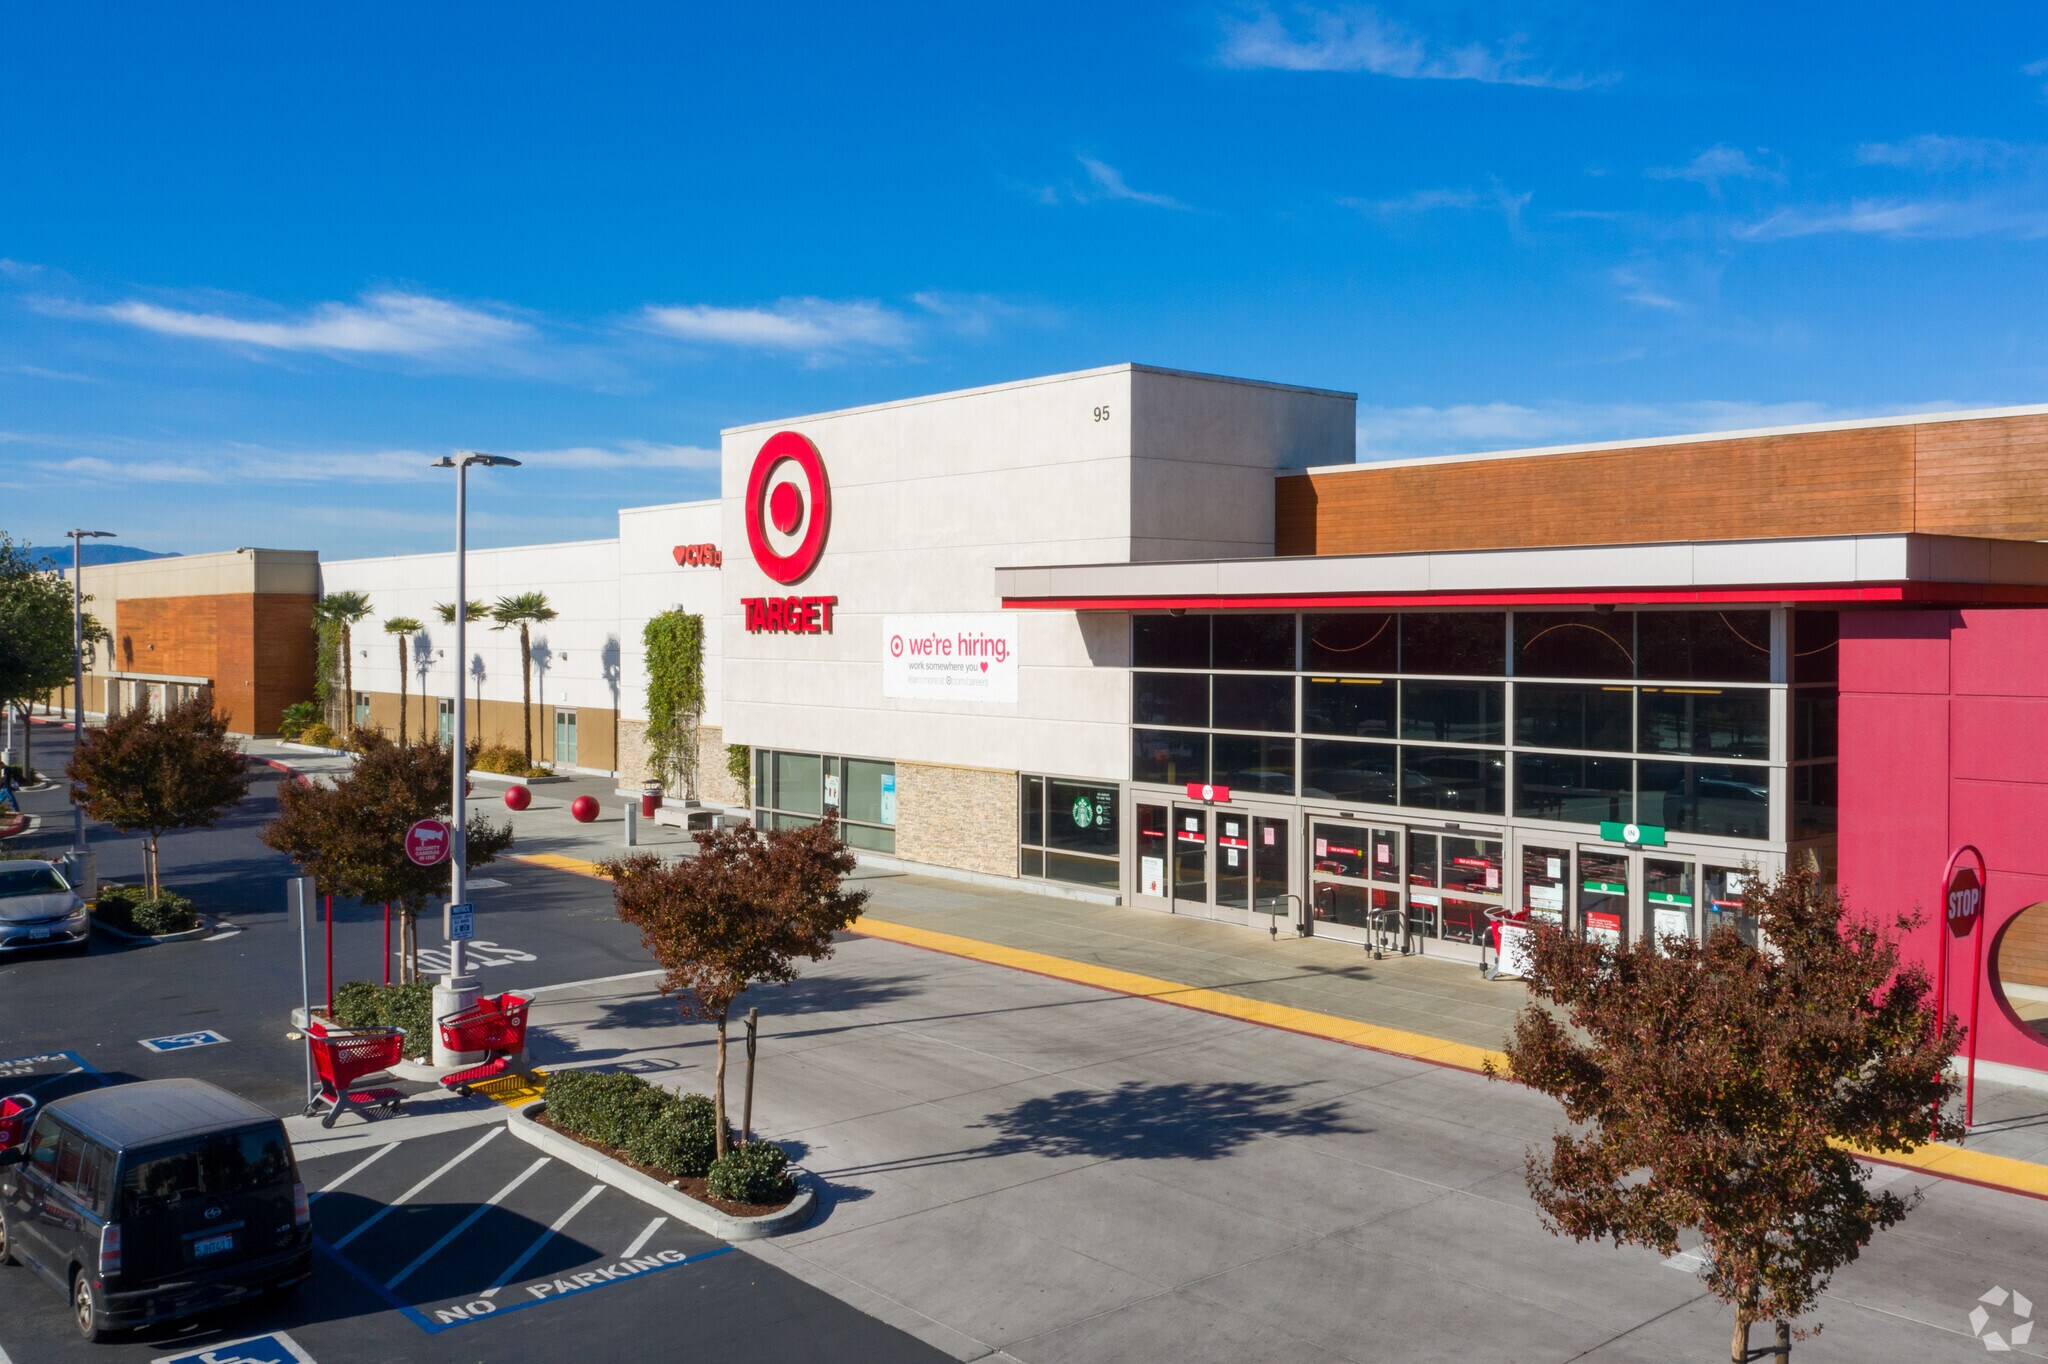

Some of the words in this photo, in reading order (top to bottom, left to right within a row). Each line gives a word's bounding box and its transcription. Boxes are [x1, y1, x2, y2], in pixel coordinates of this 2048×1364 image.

[1094, 405, 1110, 423] 95
[740, 595, 838, 634] TARGET
[908, 632, 952, 656] we're
[957, 632, 1010, 663] hiring.
[908, 661, 925, 670] work
[925, 662, 964, 671] somewhere
[965, 663, 979, 673] you
[1627, 829, 1636, 837] IN
[1948, 888, 1979, 919] STOP
[434, 1300, 497, 1325] NO
[526, 1250, 687, 1300] PARKING
